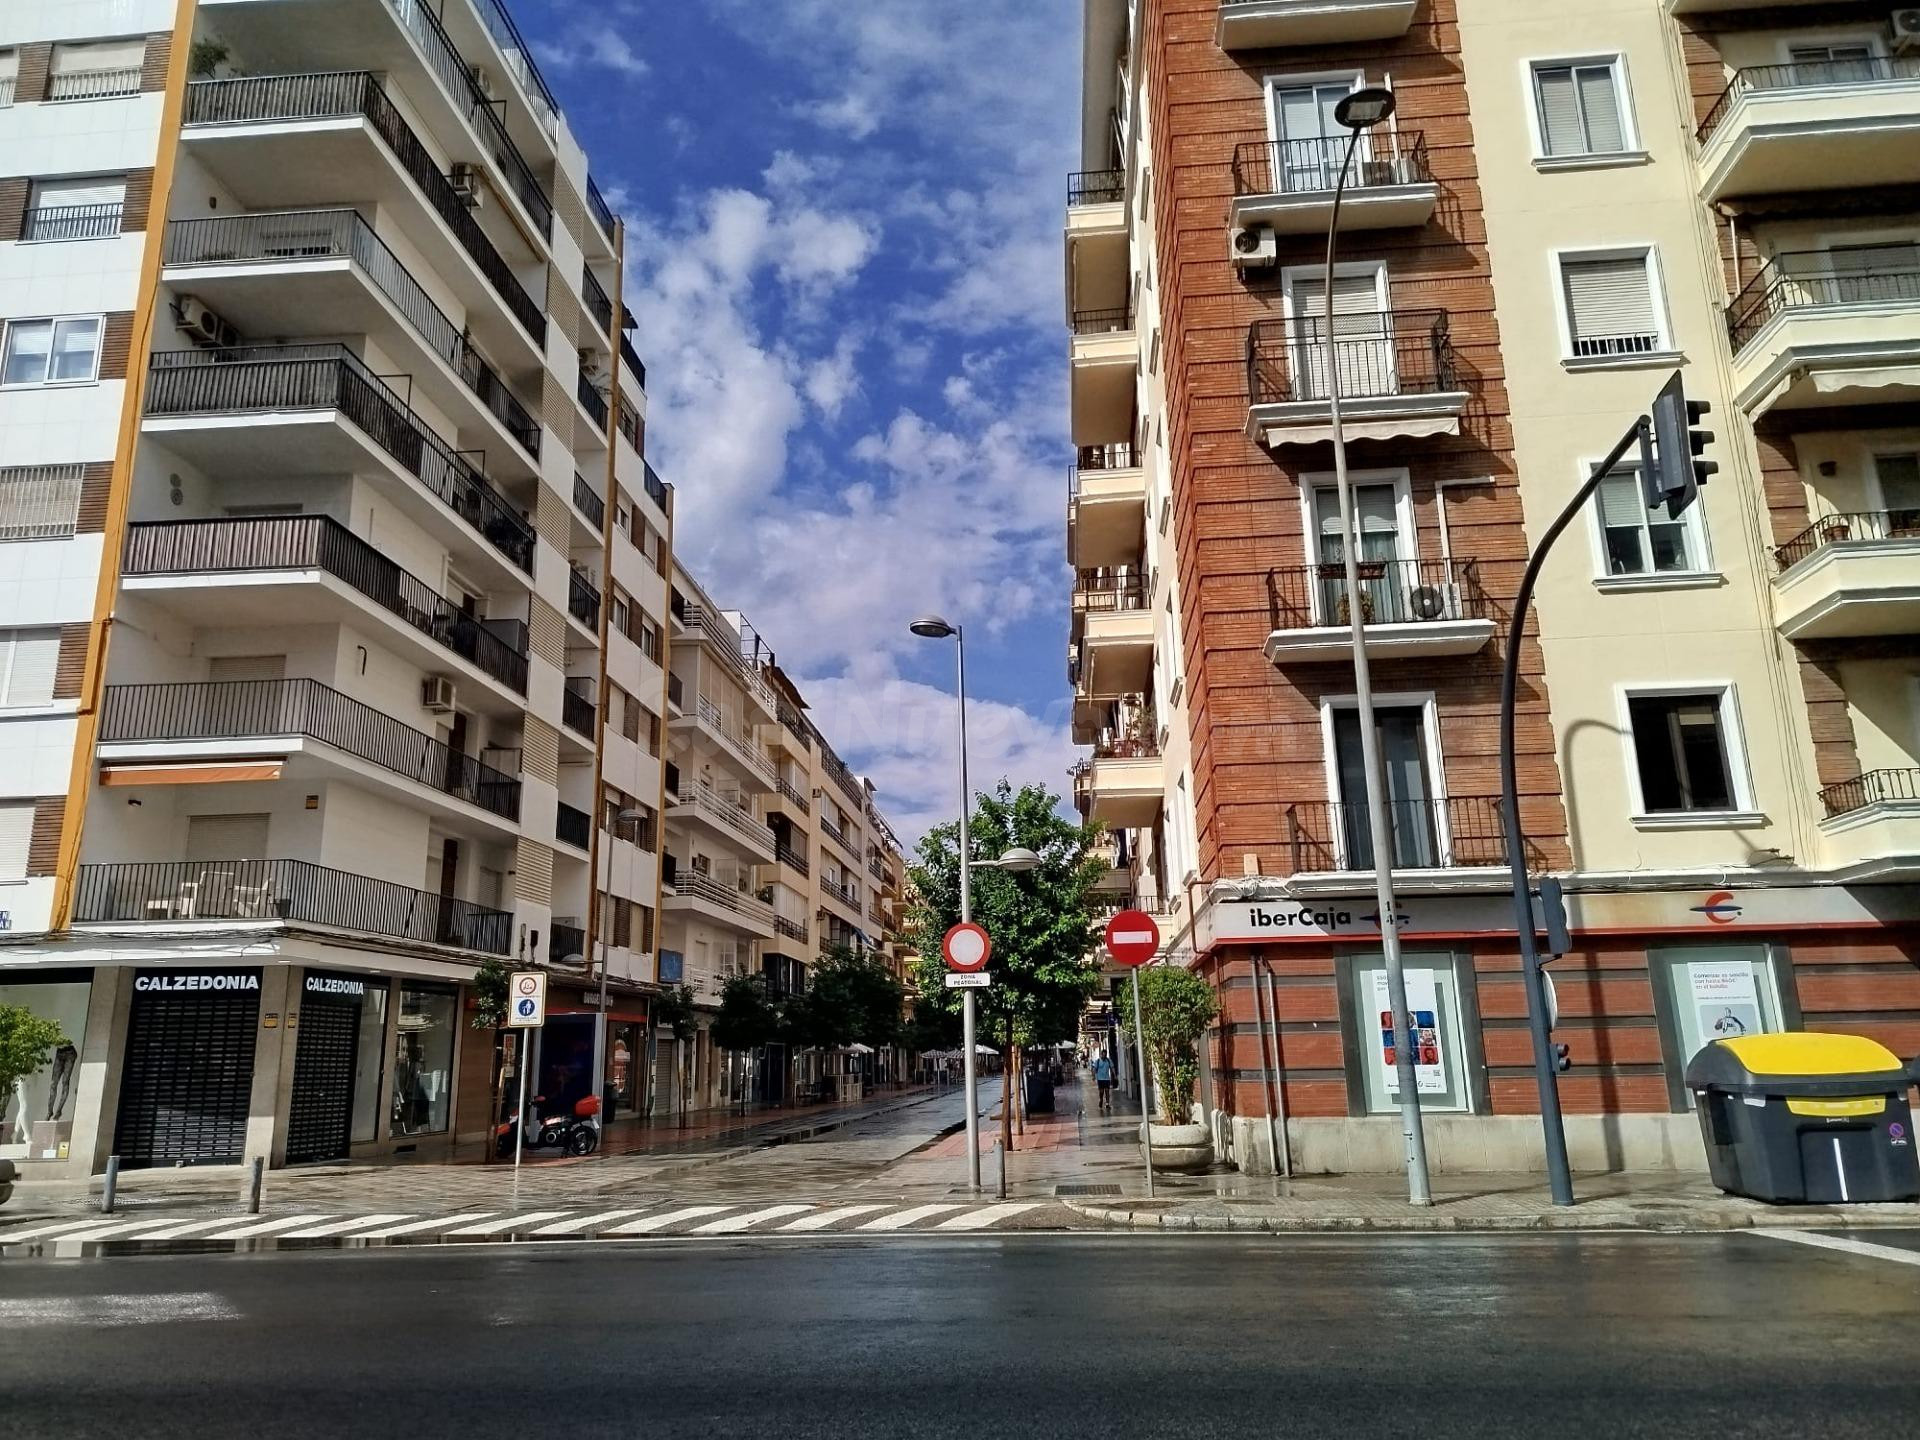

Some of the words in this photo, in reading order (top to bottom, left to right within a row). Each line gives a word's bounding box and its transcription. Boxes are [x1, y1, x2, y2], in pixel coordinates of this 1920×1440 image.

[1249, 906, 1352, 930] iberCaja
[135, 975, 259, 991] CALZEDONIA
[306, 976, 364, 995] CALZEDONIA
